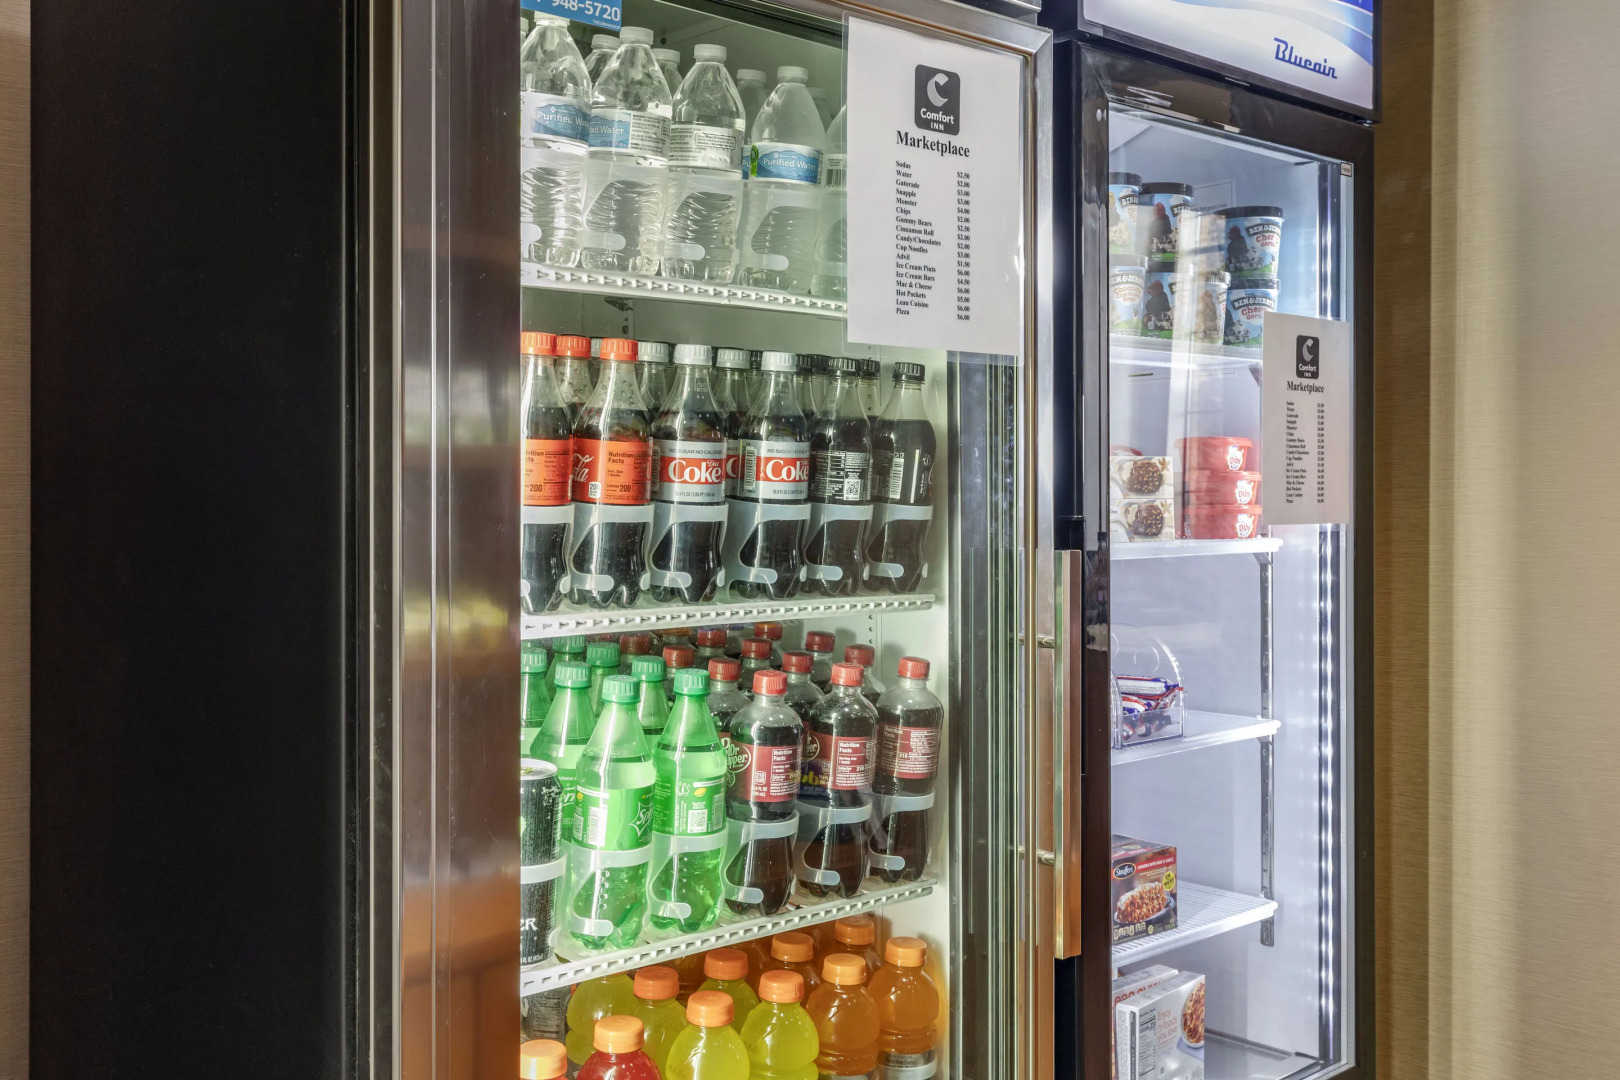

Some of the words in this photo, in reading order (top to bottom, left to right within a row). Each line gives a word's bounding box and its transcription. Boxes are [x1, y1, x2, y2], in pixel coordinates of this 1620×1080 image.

[1274, 37, 1337, 79] Blueair
[537, 110, 573, 124] Purified
[575, 117, 589, 128] Wate
[920, 108, 955, 124] Comfort
[600, 125, 624, 135] Water
[930, 122, 944, 131] INN
[896, 130, 970, 157] Marketplace
[762, 158, 794, 167] Purified
[796, 160, 816, 170] Water
[896, 160, 911, 169] Sodas
[896, 170, 912, 178] Water
[896, 179, 920, 188] Gatorade
[896, 188, 916, 198] Snapple
[896, 198, 917, 206] Monster
[896, 206, 911, 216] Chips
[896, 216, 916, 226] Gummy
[896, 225, 922, 234] Cinnamon
[896, 243, 907, 252] Cup
[908, 245, 928, 254] Noodles
[905, 262, 922, 271] Cream
[924, 265, 936, 273] Pints
[905, 272, 922, 280] Cream
[914, 282, 932, 290] Cheese
[907, 290, 926, 299] Pockets
[910, 300, 929, 308] Cuisine
[1299, 364, 1317, 372] Comfort
[1287, 380, 1324, 395] Marketplace
[668, 460, 721, 482] Coke
[766, 459, 809, 481] Coke
[530, 484, 542, 492] 200
